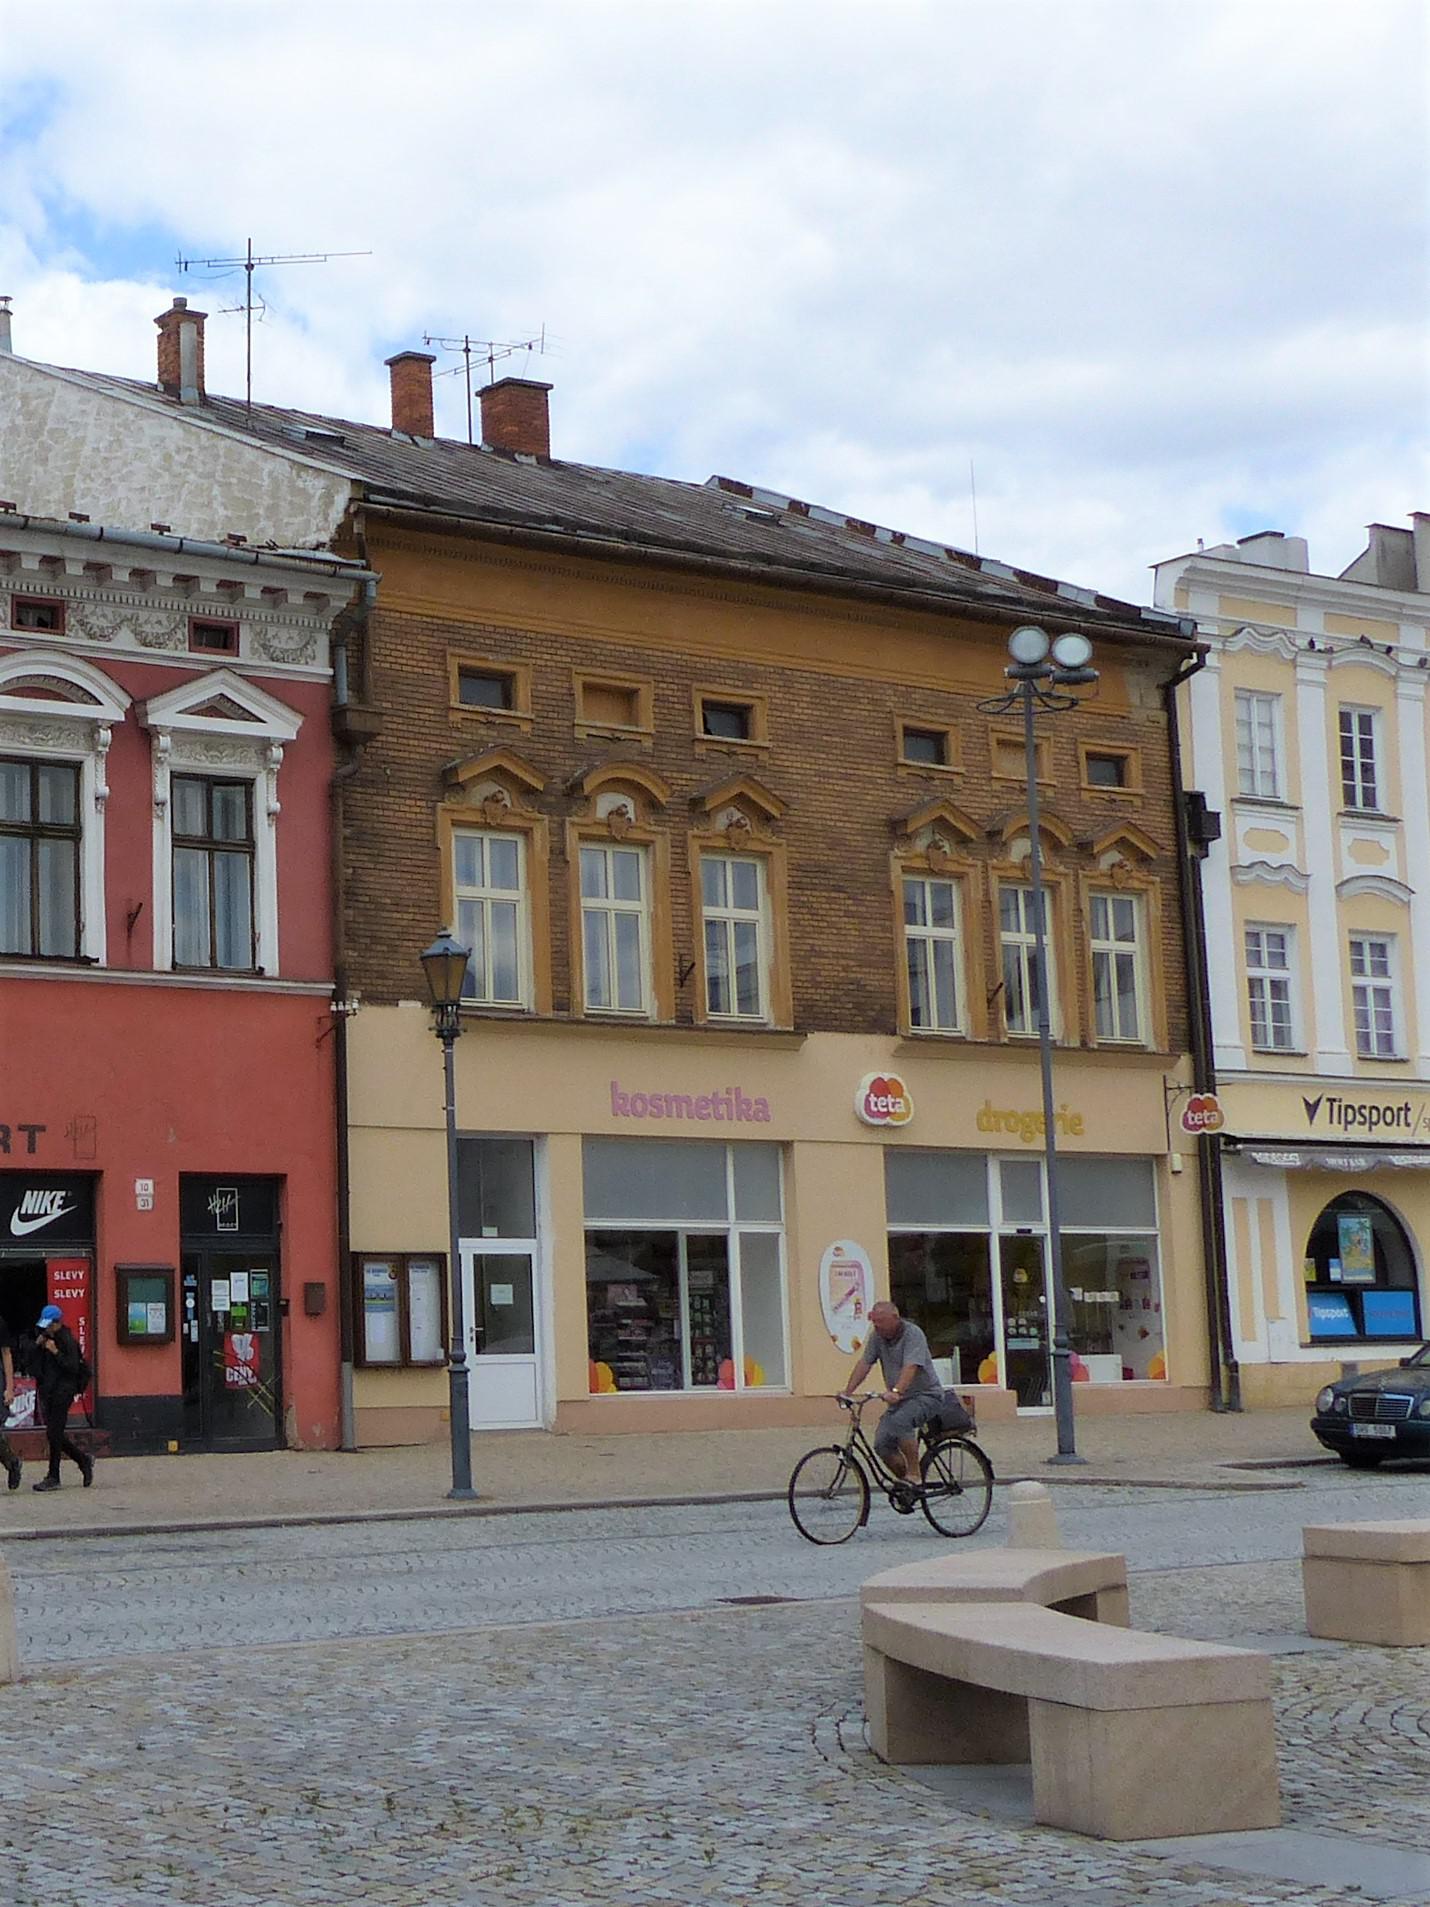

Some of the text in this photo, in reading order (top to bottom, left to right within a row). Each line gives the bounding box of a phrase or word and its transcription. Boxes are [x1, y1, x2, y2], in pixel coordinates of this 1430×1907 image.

[610, 1080, 771, 1122] kosmetika
[869, 1093, 905, 1112] teta
[1188, 1110, 1217, 1125] teta
[1326, 1097, 1412, 1132] Tipsport
[20, 1190, 66, 1215] NIKE
[54, 1271, 85, 1280] SLEVY
[54, 1289, 85, 1298] SLEVY
